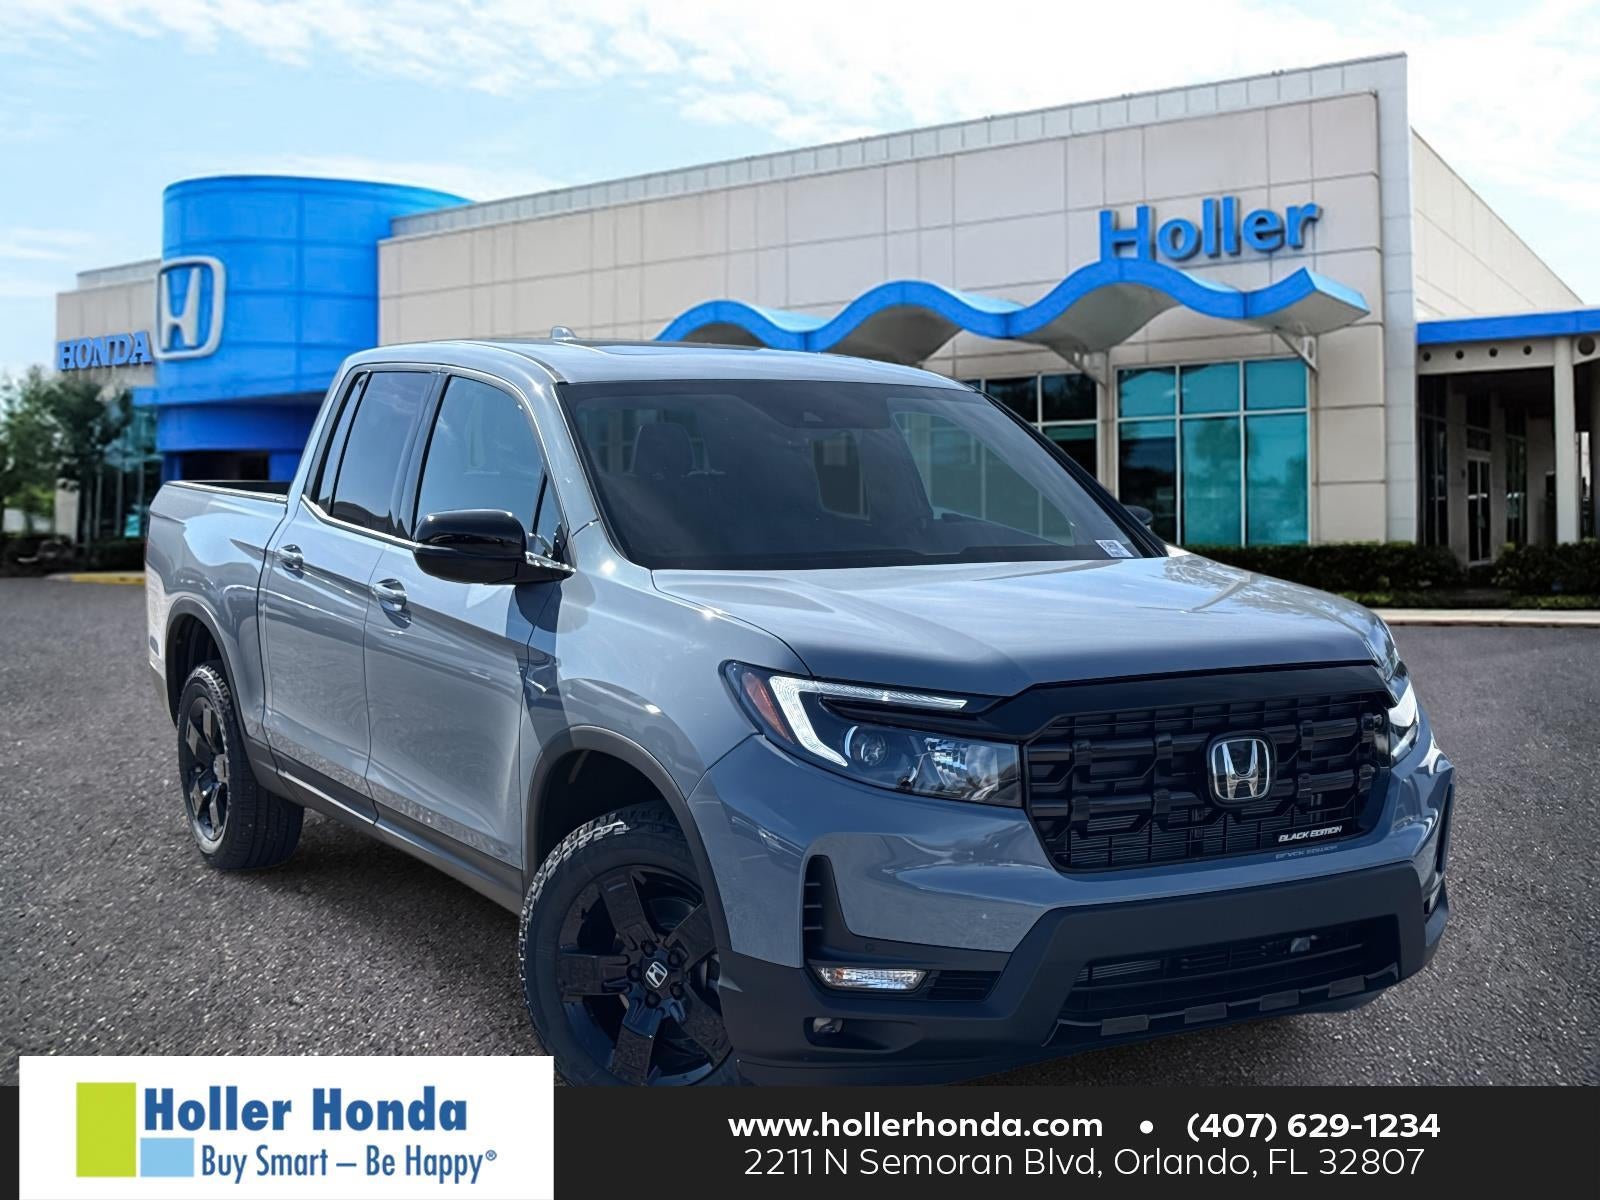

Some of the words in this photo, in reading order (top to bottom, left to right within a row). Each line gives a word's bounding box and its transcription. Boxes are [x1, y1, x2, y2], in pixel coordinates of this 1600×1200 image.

[1099, 196, 1321, 262] Holler
[57, 331, 152, 370] HONDA
[1279, 831, 1309, 842] BLACK
[1310, 825, 1342, 838] EDITION
